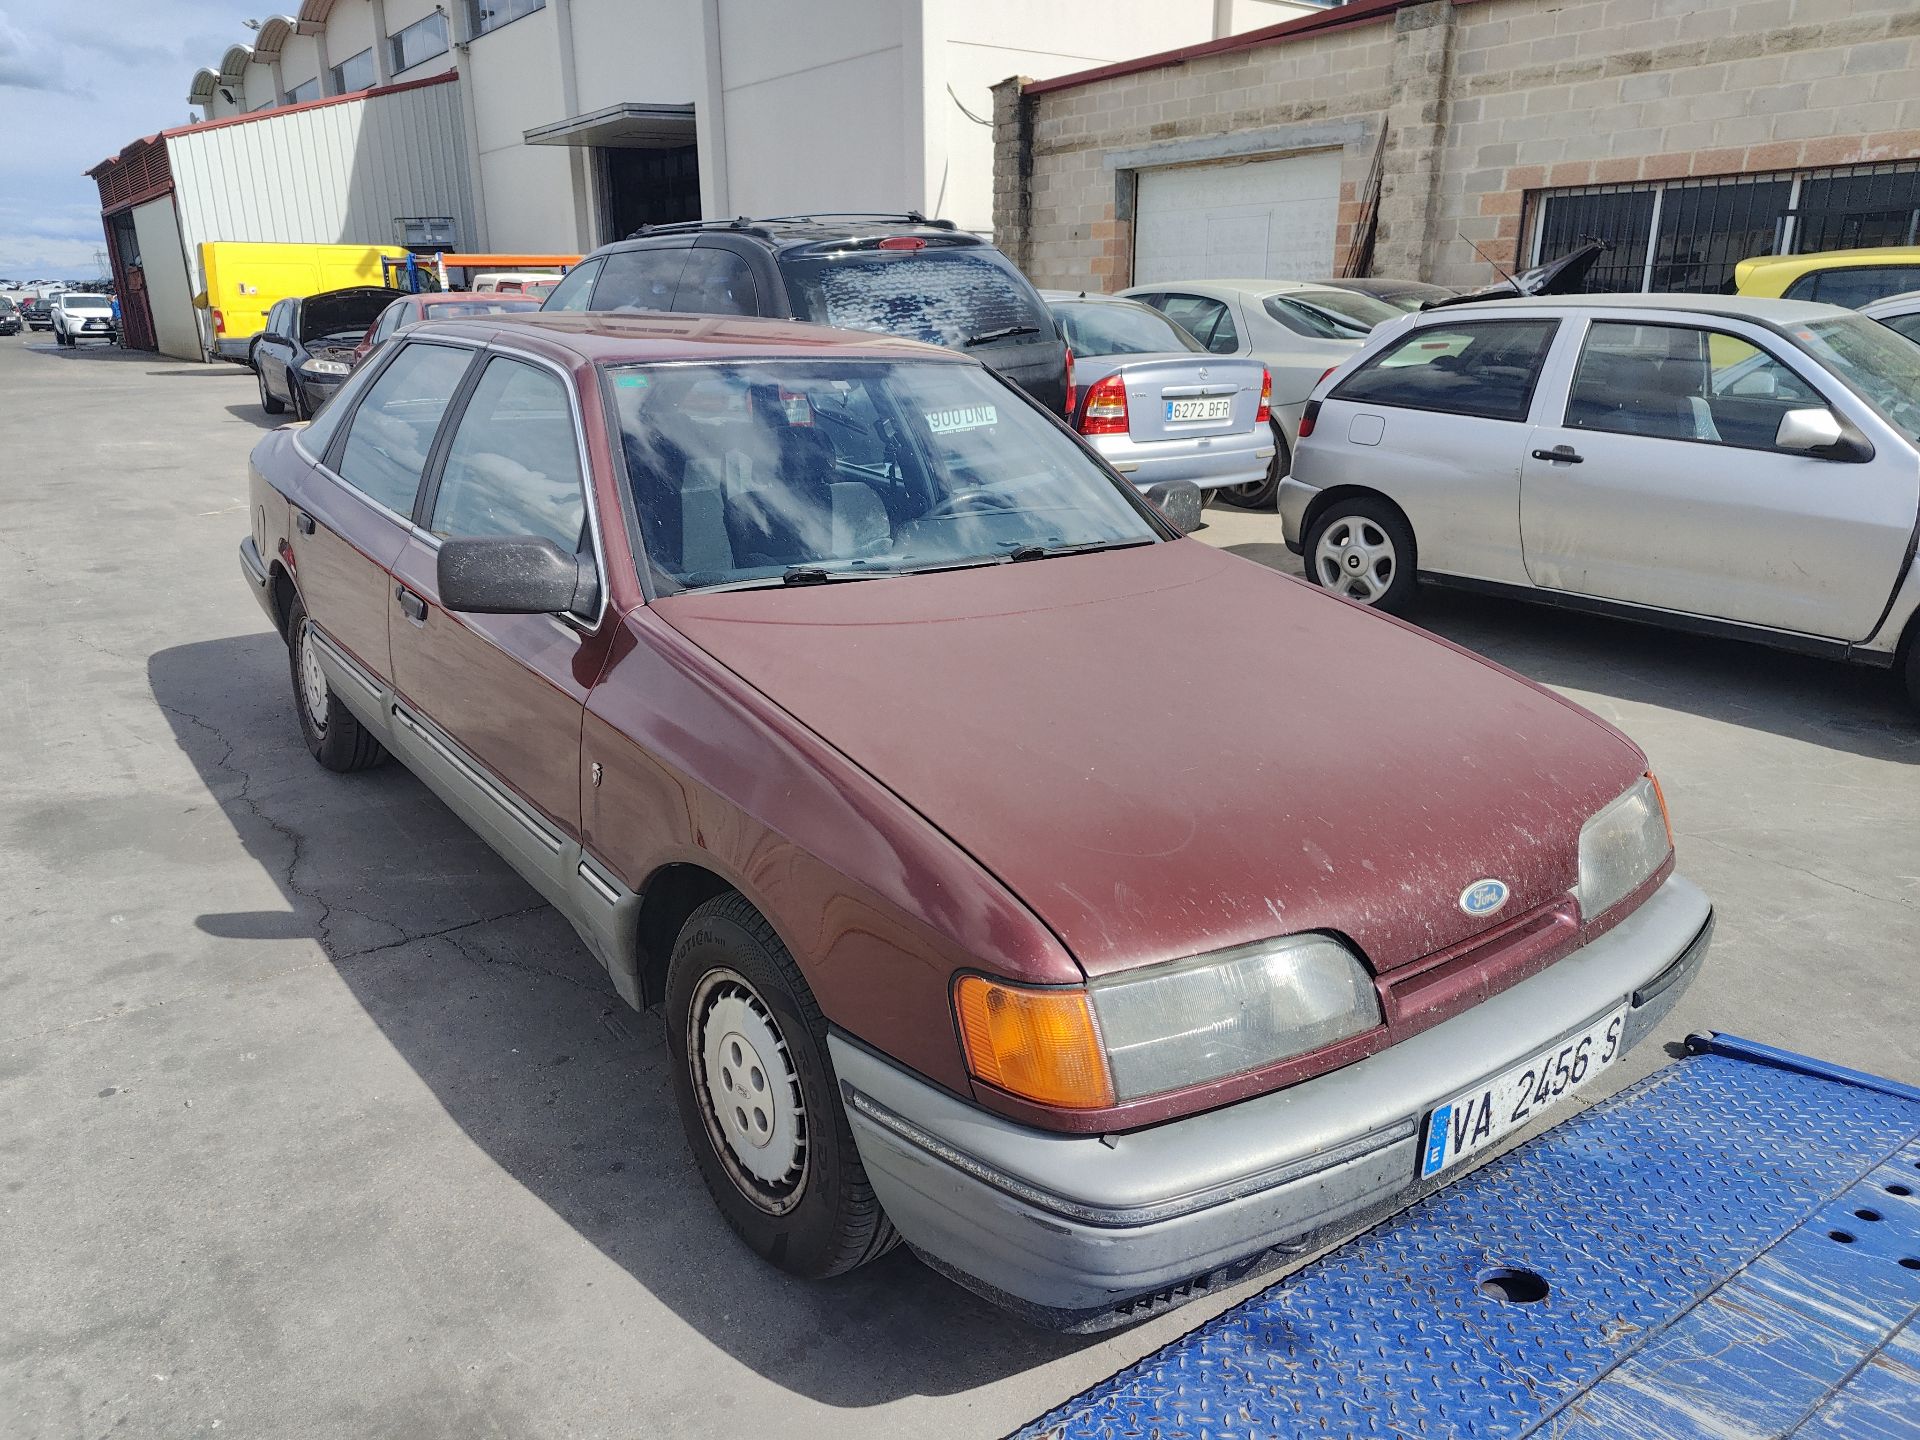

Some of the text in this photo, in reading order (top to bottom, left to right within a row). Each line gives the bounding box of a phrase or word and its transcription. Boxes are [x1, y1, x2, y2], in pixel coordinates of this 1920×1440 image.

[925, 405, 994, 428] 900 DNL
[1174, 401, 1229, 418] 6272 BFR
[1473, 886, 1499, 908] Ford
[1454, 1016, 1621, 1155] VA 2456 S
[1430, 1146, 1440, 1163] E
